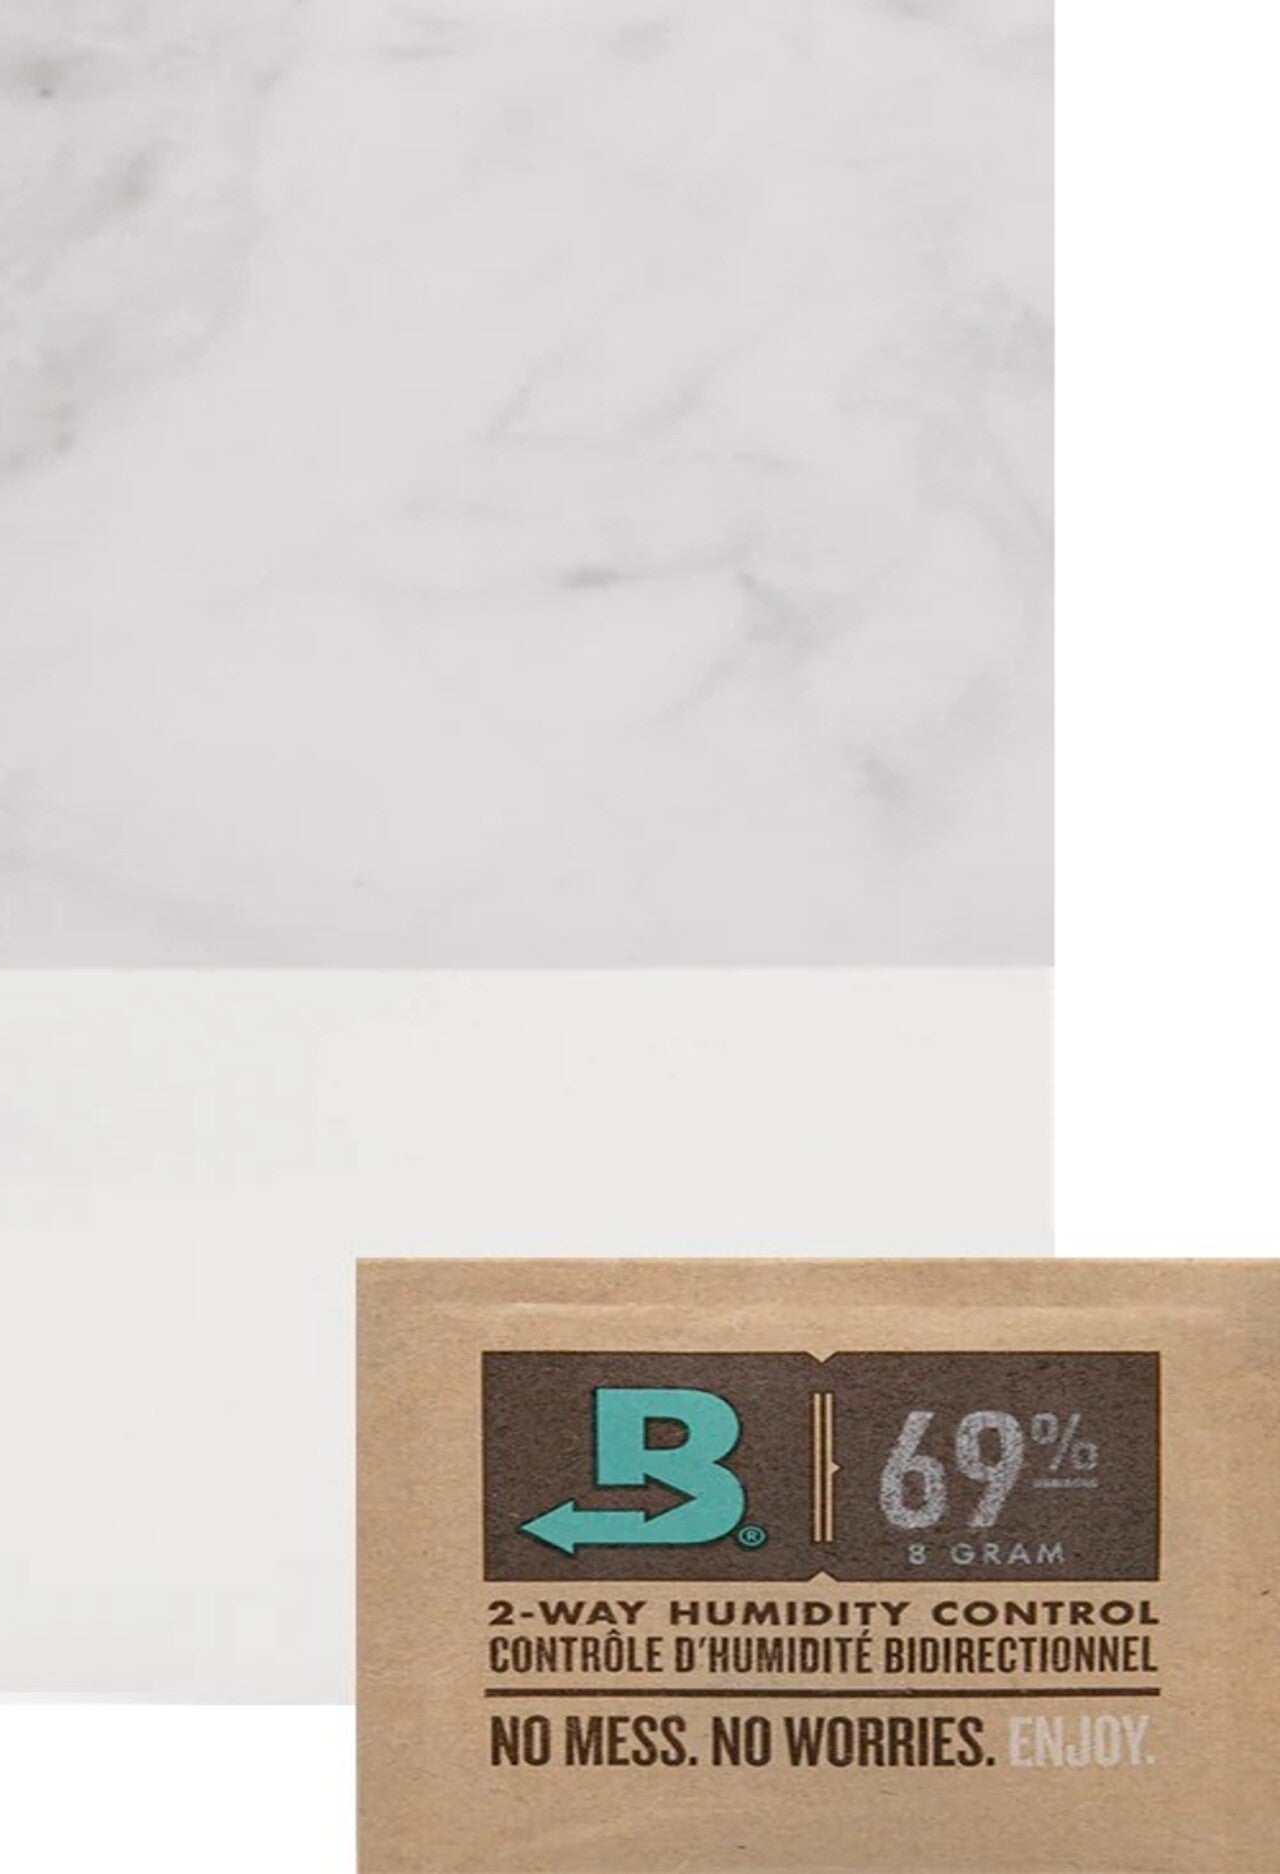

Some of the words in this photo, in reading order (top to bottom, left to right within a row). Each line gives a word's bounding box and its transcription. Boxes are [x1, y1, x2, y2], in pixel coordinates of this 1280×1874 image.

[879, 1409, 1099, 1530] 69%
[908, 1543, 926, 1566] 8
[951, 1542, 1066, 1566] GRAM
[487, 1600, 647, 1627] 2-WAY
[669, 1600, 911, 1627] HUMIDITY
[931, 1600, 1160, 1627] CONTROL
[488, 1629, 664, 1674] CONTRÔLE
[674, 1629, 873, 1674] D'HUMIDITÉ
[884, 1635, 1159, 1674] BIDIRECTIONNEL
[490, 1714, 551, 1767] NO
[565, 1714, 698, 1767] MESS.
[711, 1715, 772, 1768] NO
[783, 1715, 996, 1768] WORRIES.
[1009, 1714, 1155, 1769] ENJOY.
